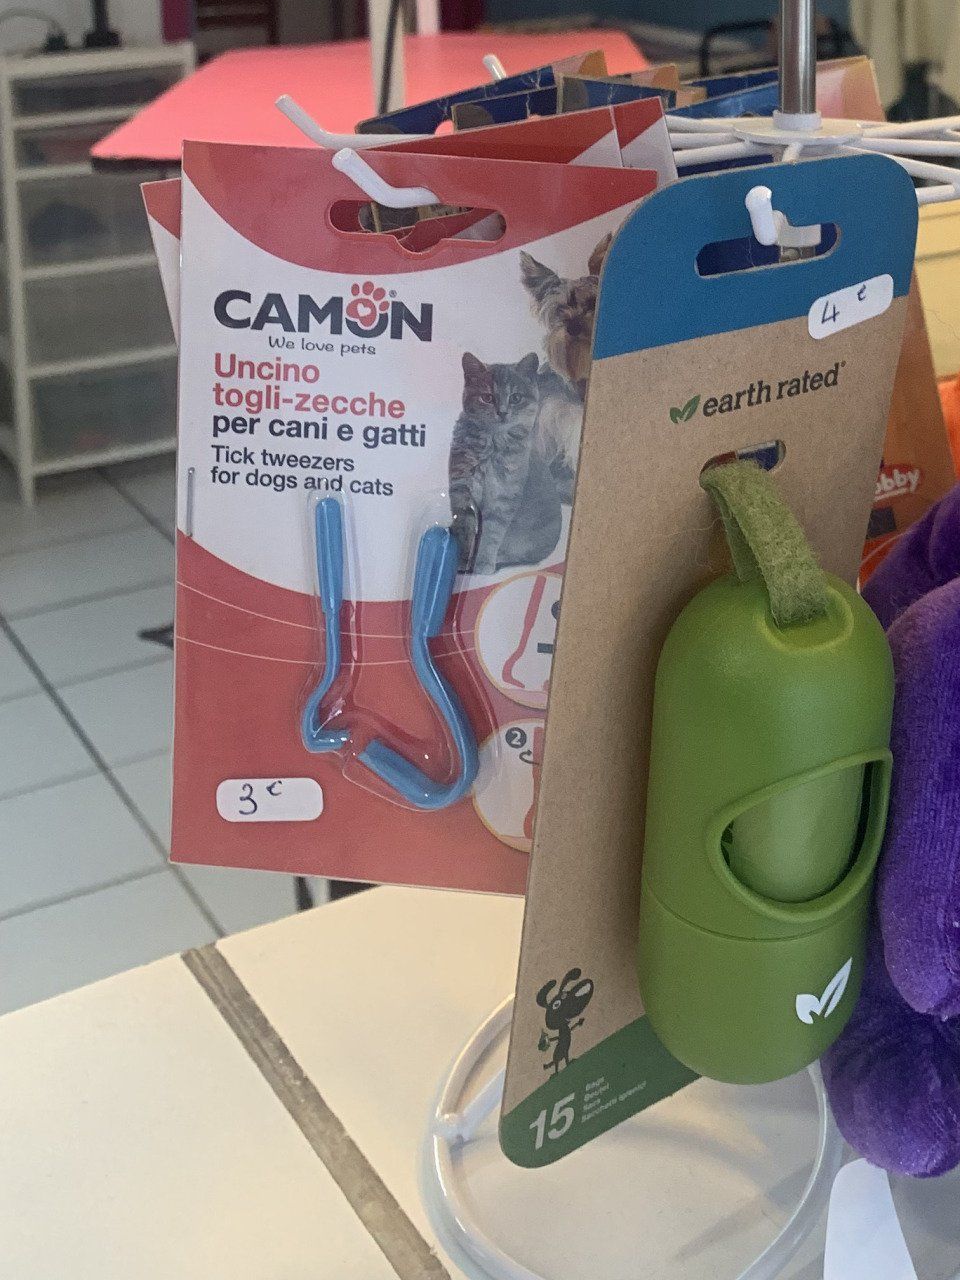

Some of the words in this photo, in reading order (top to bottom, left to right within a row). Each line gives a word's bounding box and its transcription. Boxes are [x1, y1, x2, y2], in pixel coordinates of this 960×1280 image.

[213, 289, 433, 343] CAMON
[268, 335, 295, 350] We
[301, 337, 334, 353] love
[340, 341, 376, 356] pets
[214, 352, 320, 384] Uncino
[212, 382, 406, 418] togli-zecche
[702, 381, 771, 418] earth
[776, 362, 839, 400] rated
[212, 414, 260, 438] per
[268, 416, 328, 441] cani
[336, 423, 354, 442] e
[362, 423, 426, 448] gatti
[211, 445, 255, 466] Tick
[261, 448, 355, 472] tweezers
[210, 466, 240, 485] for
[245, 469, 298, 492] dogs
[303, 477, 343, 492] and
[349, 478, 394, 497] cats
[529, 1093, 575, 1150] 15
